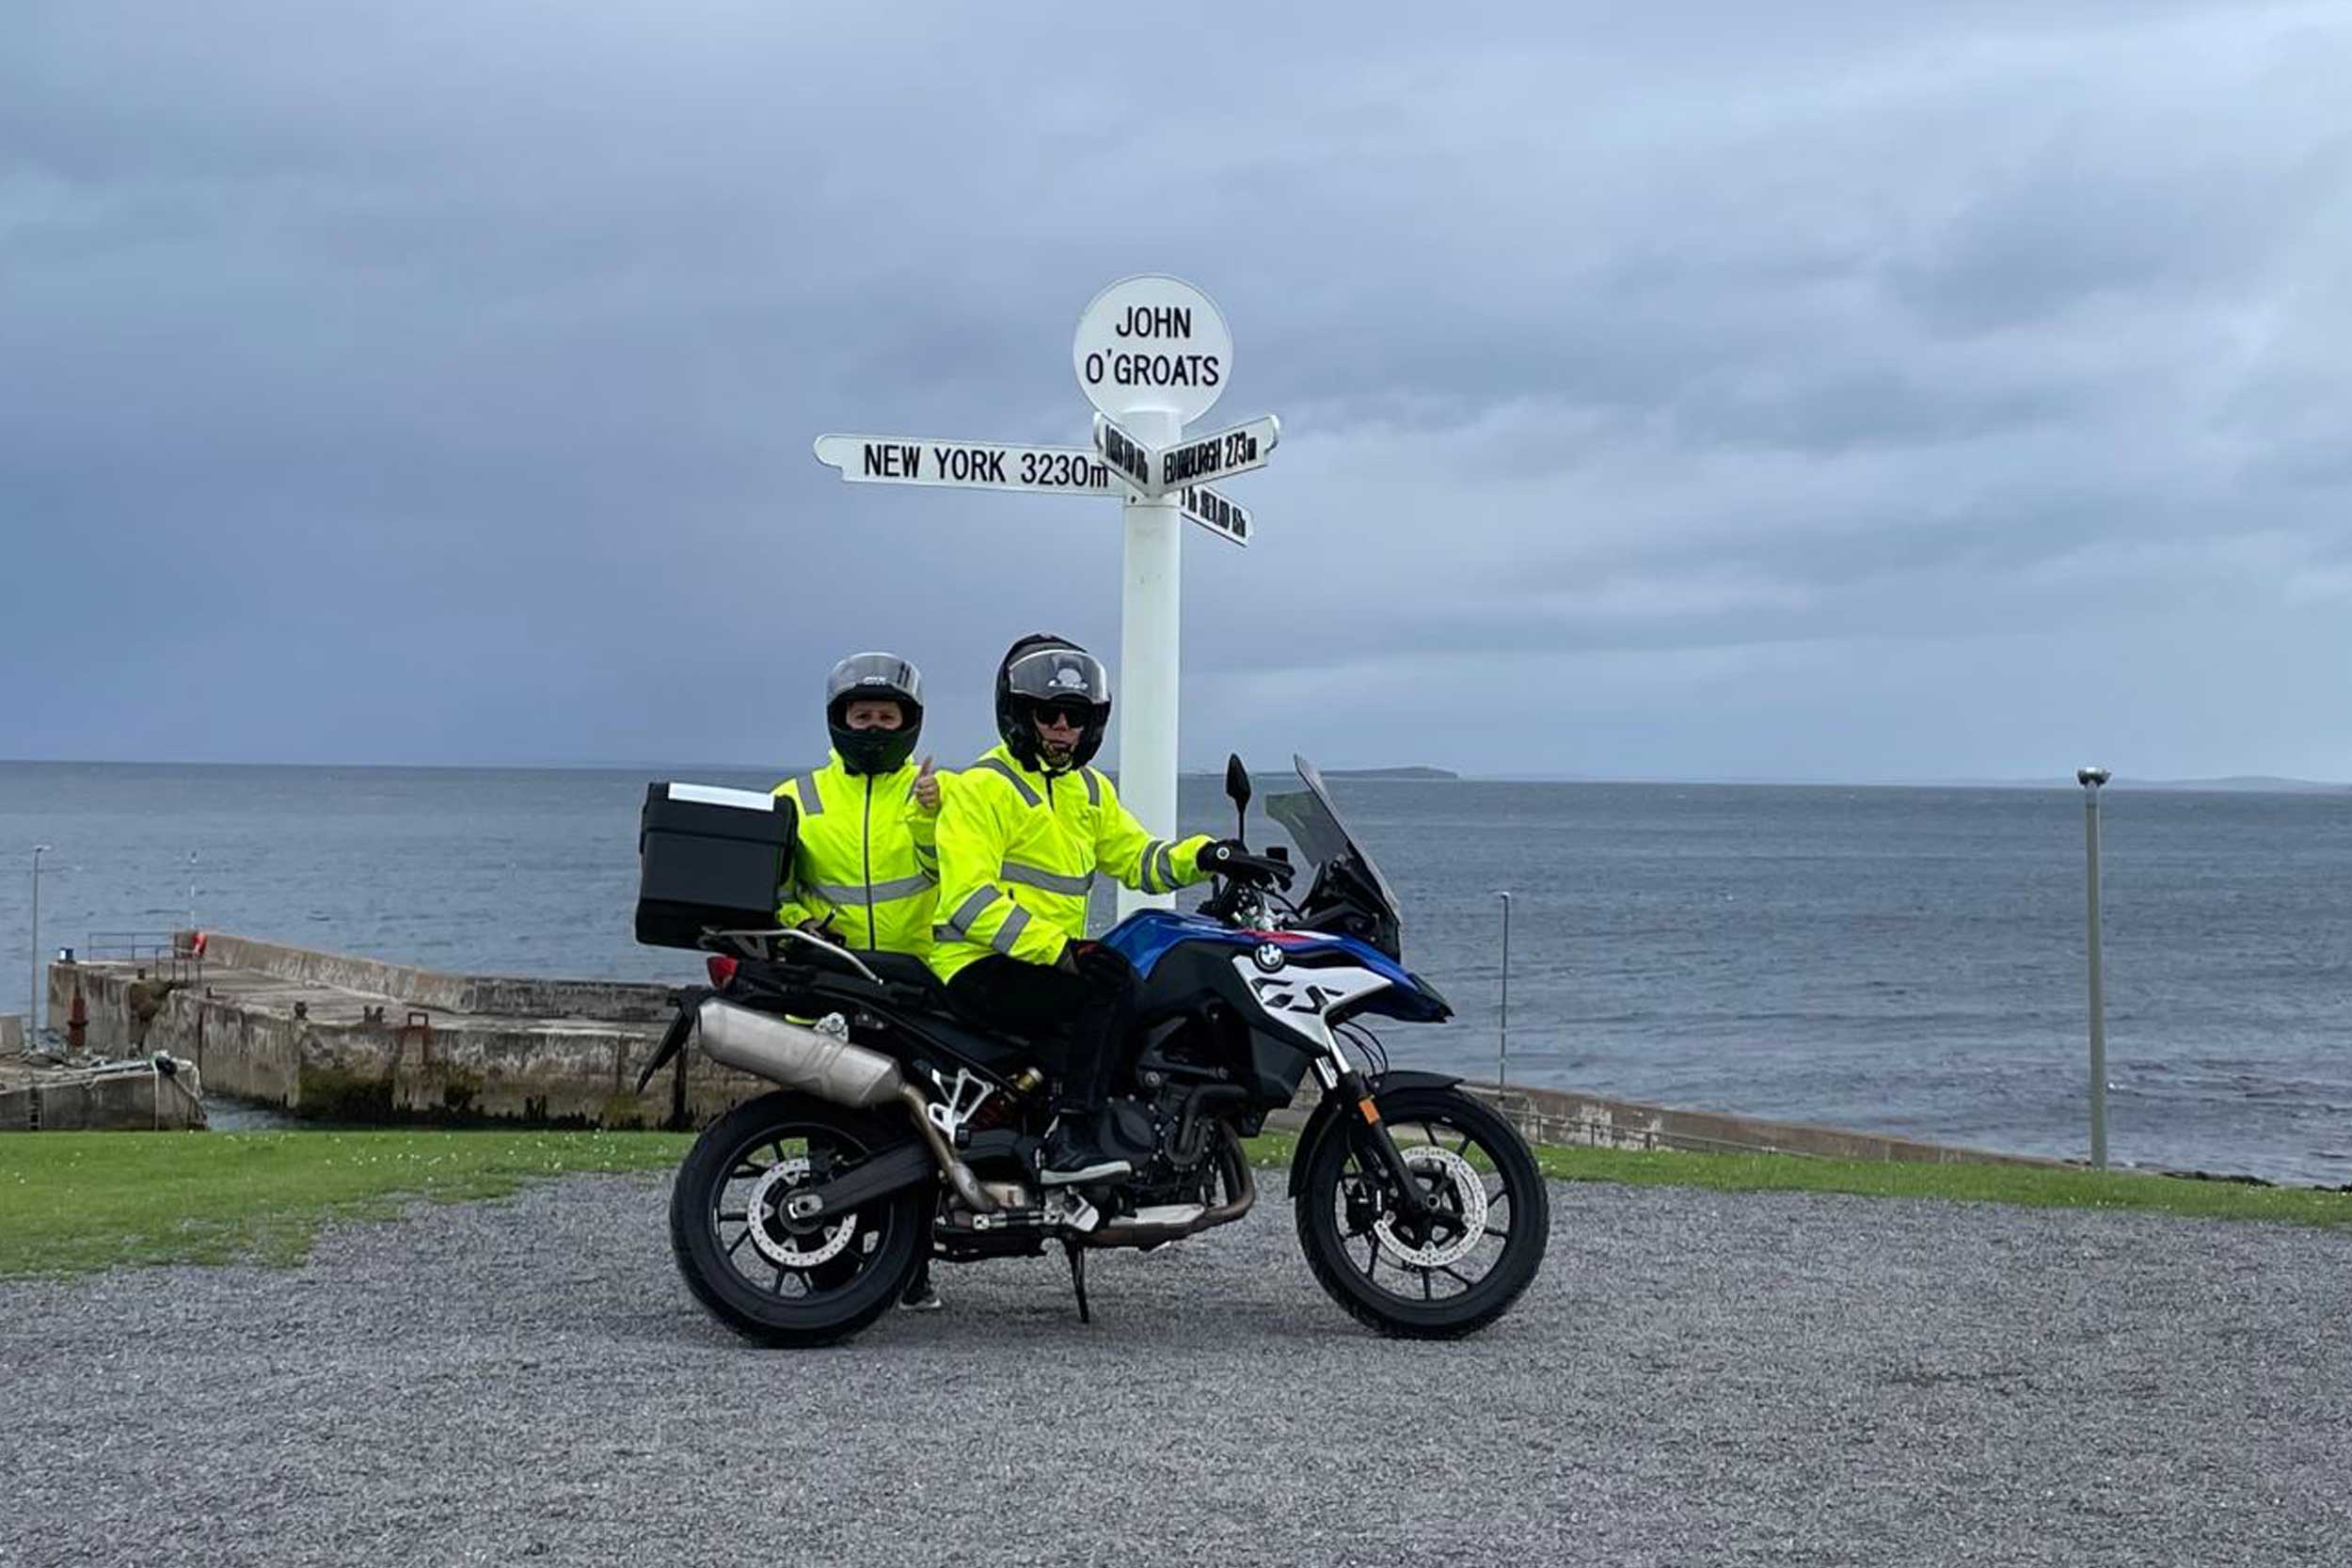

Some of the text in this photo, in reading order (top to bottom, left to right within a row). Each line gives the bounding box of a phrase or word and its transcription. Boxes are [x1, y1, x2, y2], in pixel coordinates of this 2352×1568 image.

[1116, 307, 1191, 338] JOHN
[1086, 349, 1219, 387] O'GROATS
[864, 443, 921, 479] NEW
[934, 448, 1007, 483] YORK
[1021, 452, 1109, 489] 3230m
